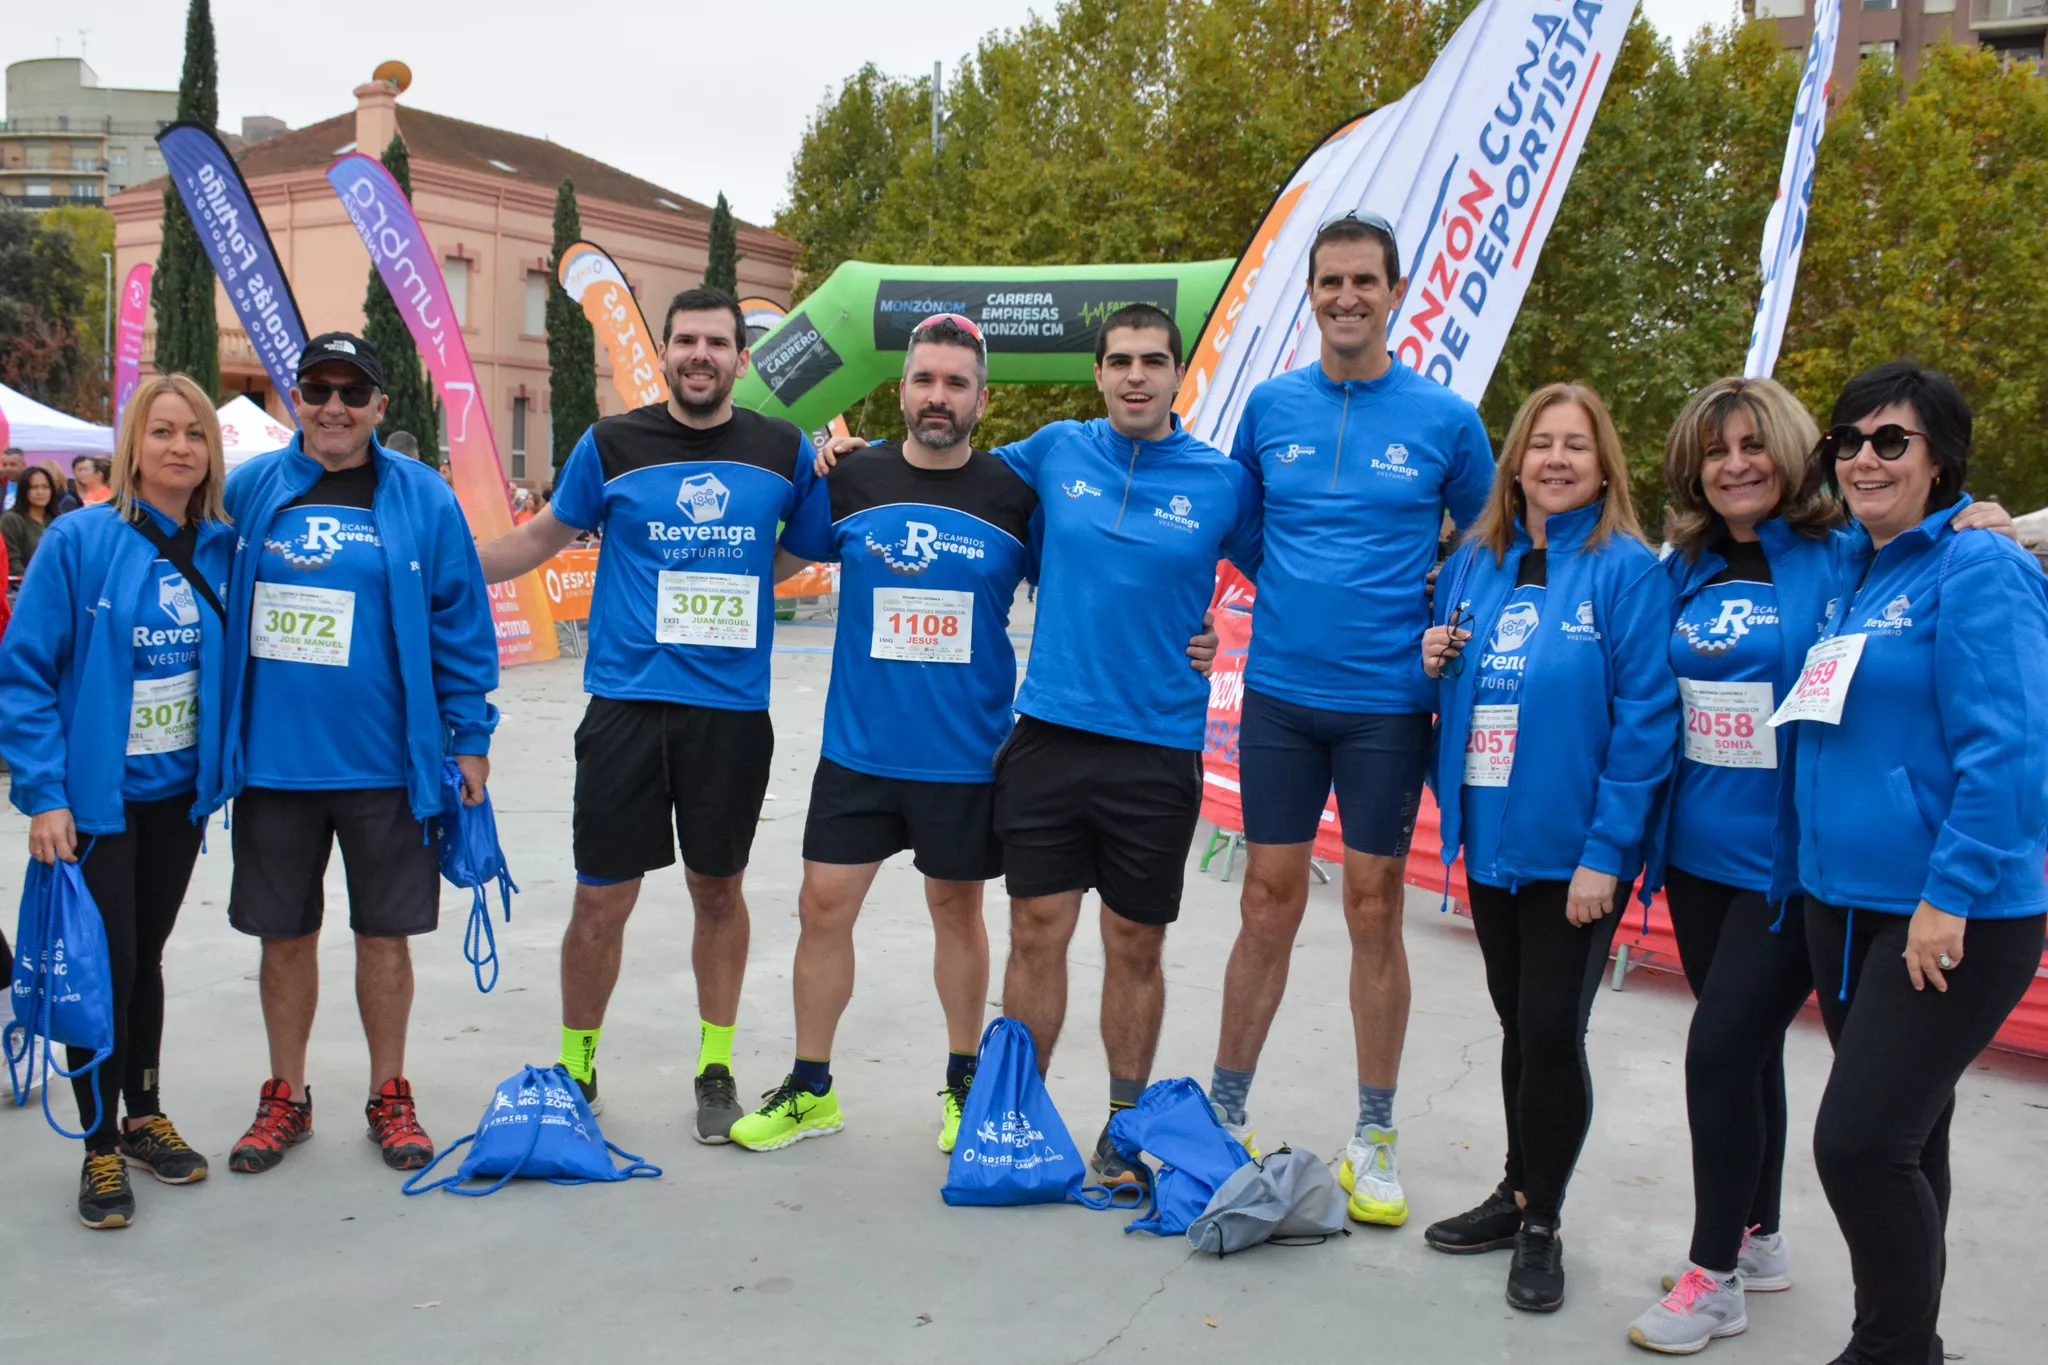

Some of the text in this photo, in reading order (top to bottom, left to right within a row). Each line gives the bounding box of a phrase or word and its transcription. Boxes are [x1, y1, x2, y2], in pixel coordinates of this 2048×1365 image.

[1396, 12, 1563, 374] ONZÓN CUNA
[1424, 0, 1604, 388] DE DEPORTISTA
[986, 292, 1054, 306] CARRERA
[981, 306, 1060, 321] EMPRESAS
[977, 319, 1065, 337] MONZÓN CM
[756, 331, 804, 372] Automóviles
[766, 329, 819, 374] CABRERO
[1371, 458, 1419, 477] Revenga
[1153, 508, 1200, 529] Revenga
[647, 521, 757, 546] Revenga
[663, 547, 744, 559] VESTUARIO
[672, 593, 744, 617] 3073
[264, 609, 337, 639] 3072
[692, 616, 716, 625] JUAN
[717, 618, 751, 627] MIGUEL
[888, 612, 958, 637] 1108
[280, 636, 301, 645] JOSE
[304, 637, 344, 649] MANUEL
[906, 636, 939, 646] JESUS
[1687, 707, 1755, 738] 2058
[1465, 729, 1518, 754] 2057
[1714, 739, 1753, 750] SONIA
[1490, 756, 1514, 765] OLG
